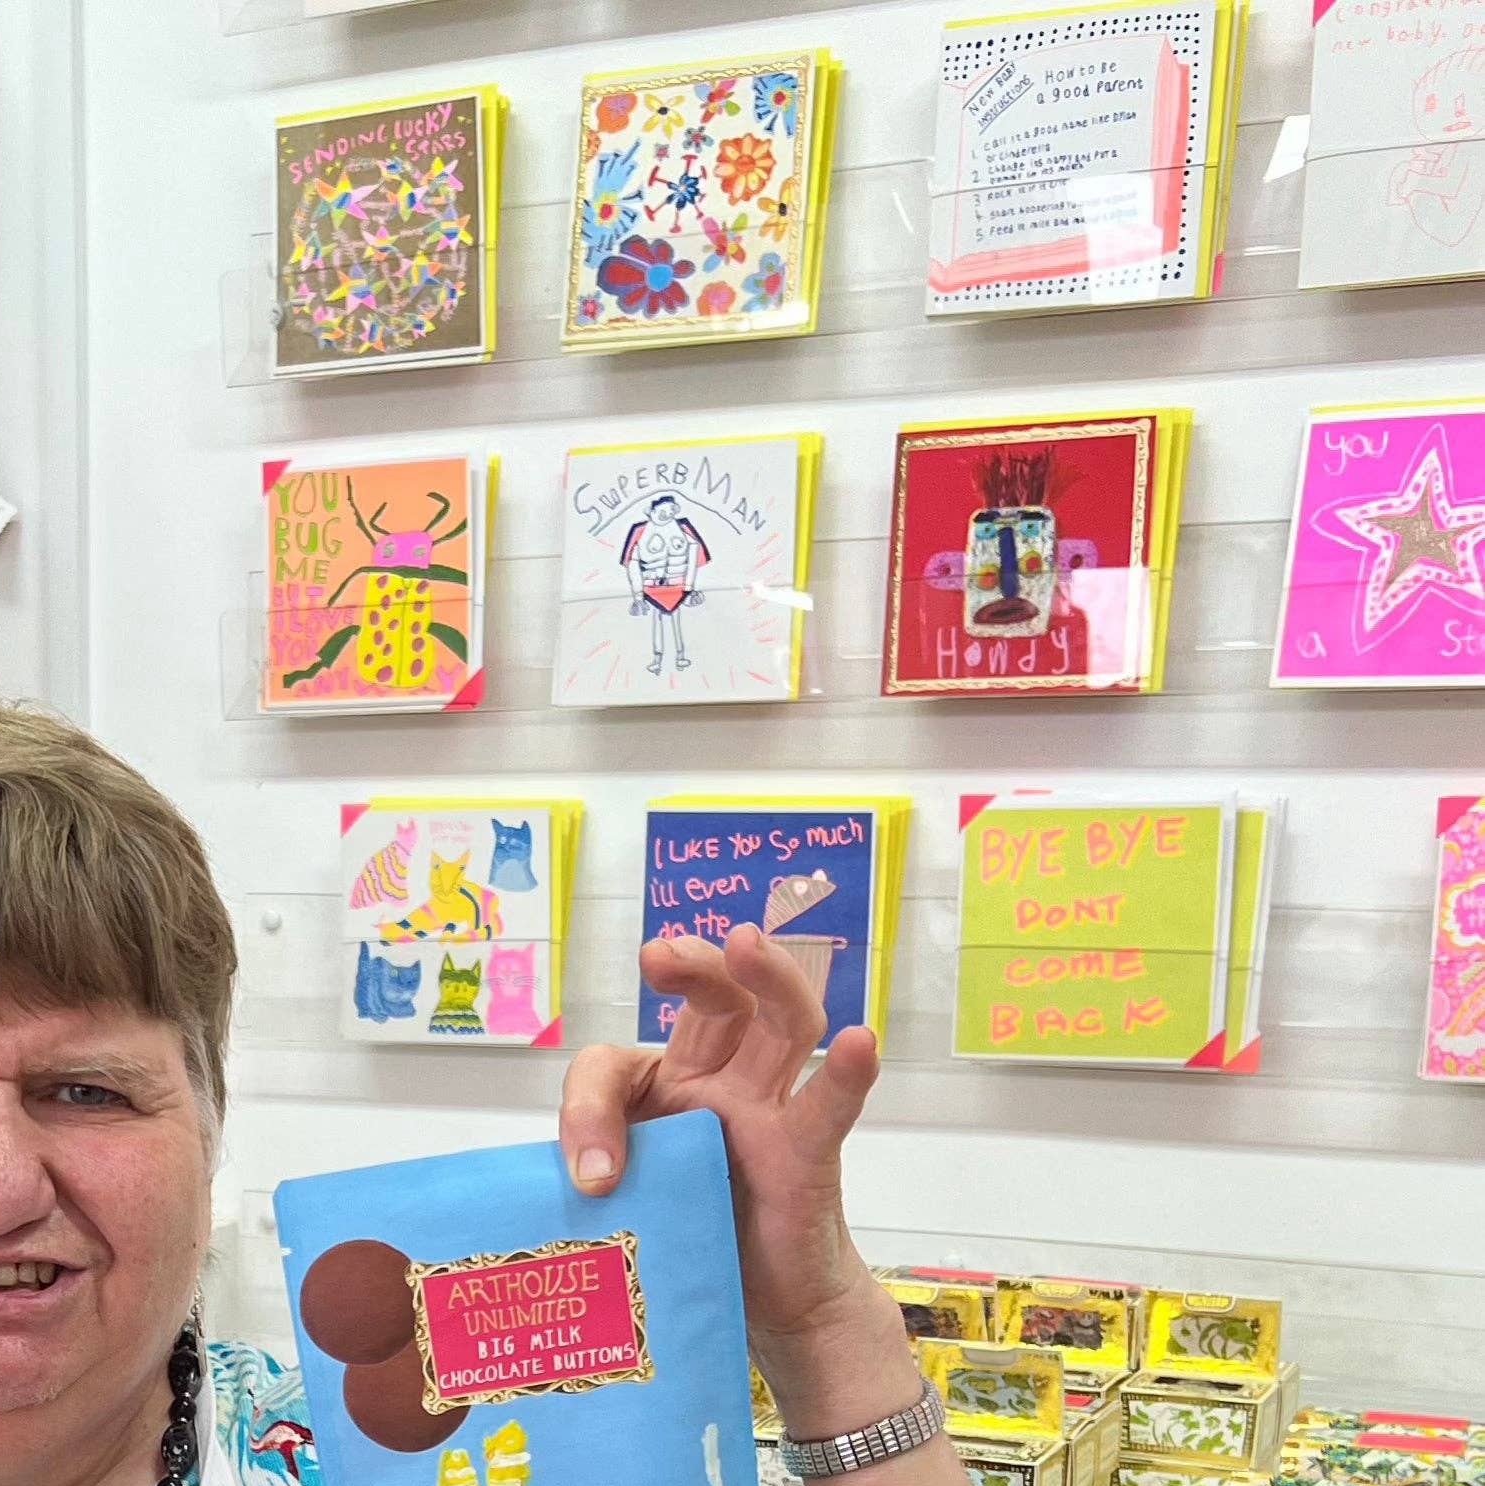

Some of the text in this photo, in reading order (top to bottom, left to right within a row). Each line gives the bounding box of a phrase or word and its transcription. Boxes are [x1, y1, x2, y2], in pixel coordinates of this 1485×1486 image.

[273, 471, 339, 517] YOU
[274, 516, 343, 559] BUG
[275, 556, 331, 585] ME
[981, 815, 1189, 884] BYE BYE
[1015, 893, 1126, 932] DONT
[1004, 949, 1146, 987] COME
[990, 995, 1170, 1045] BACK
[447, 1258, 601, 1310] ARTHOUSE
[463, 1296, 588, 1337] UNLIMITED
[477, 1325, 583, 1361] BIG MILK
[439, 1341, 637, 1390] CHOCOLATE BUTTONS
